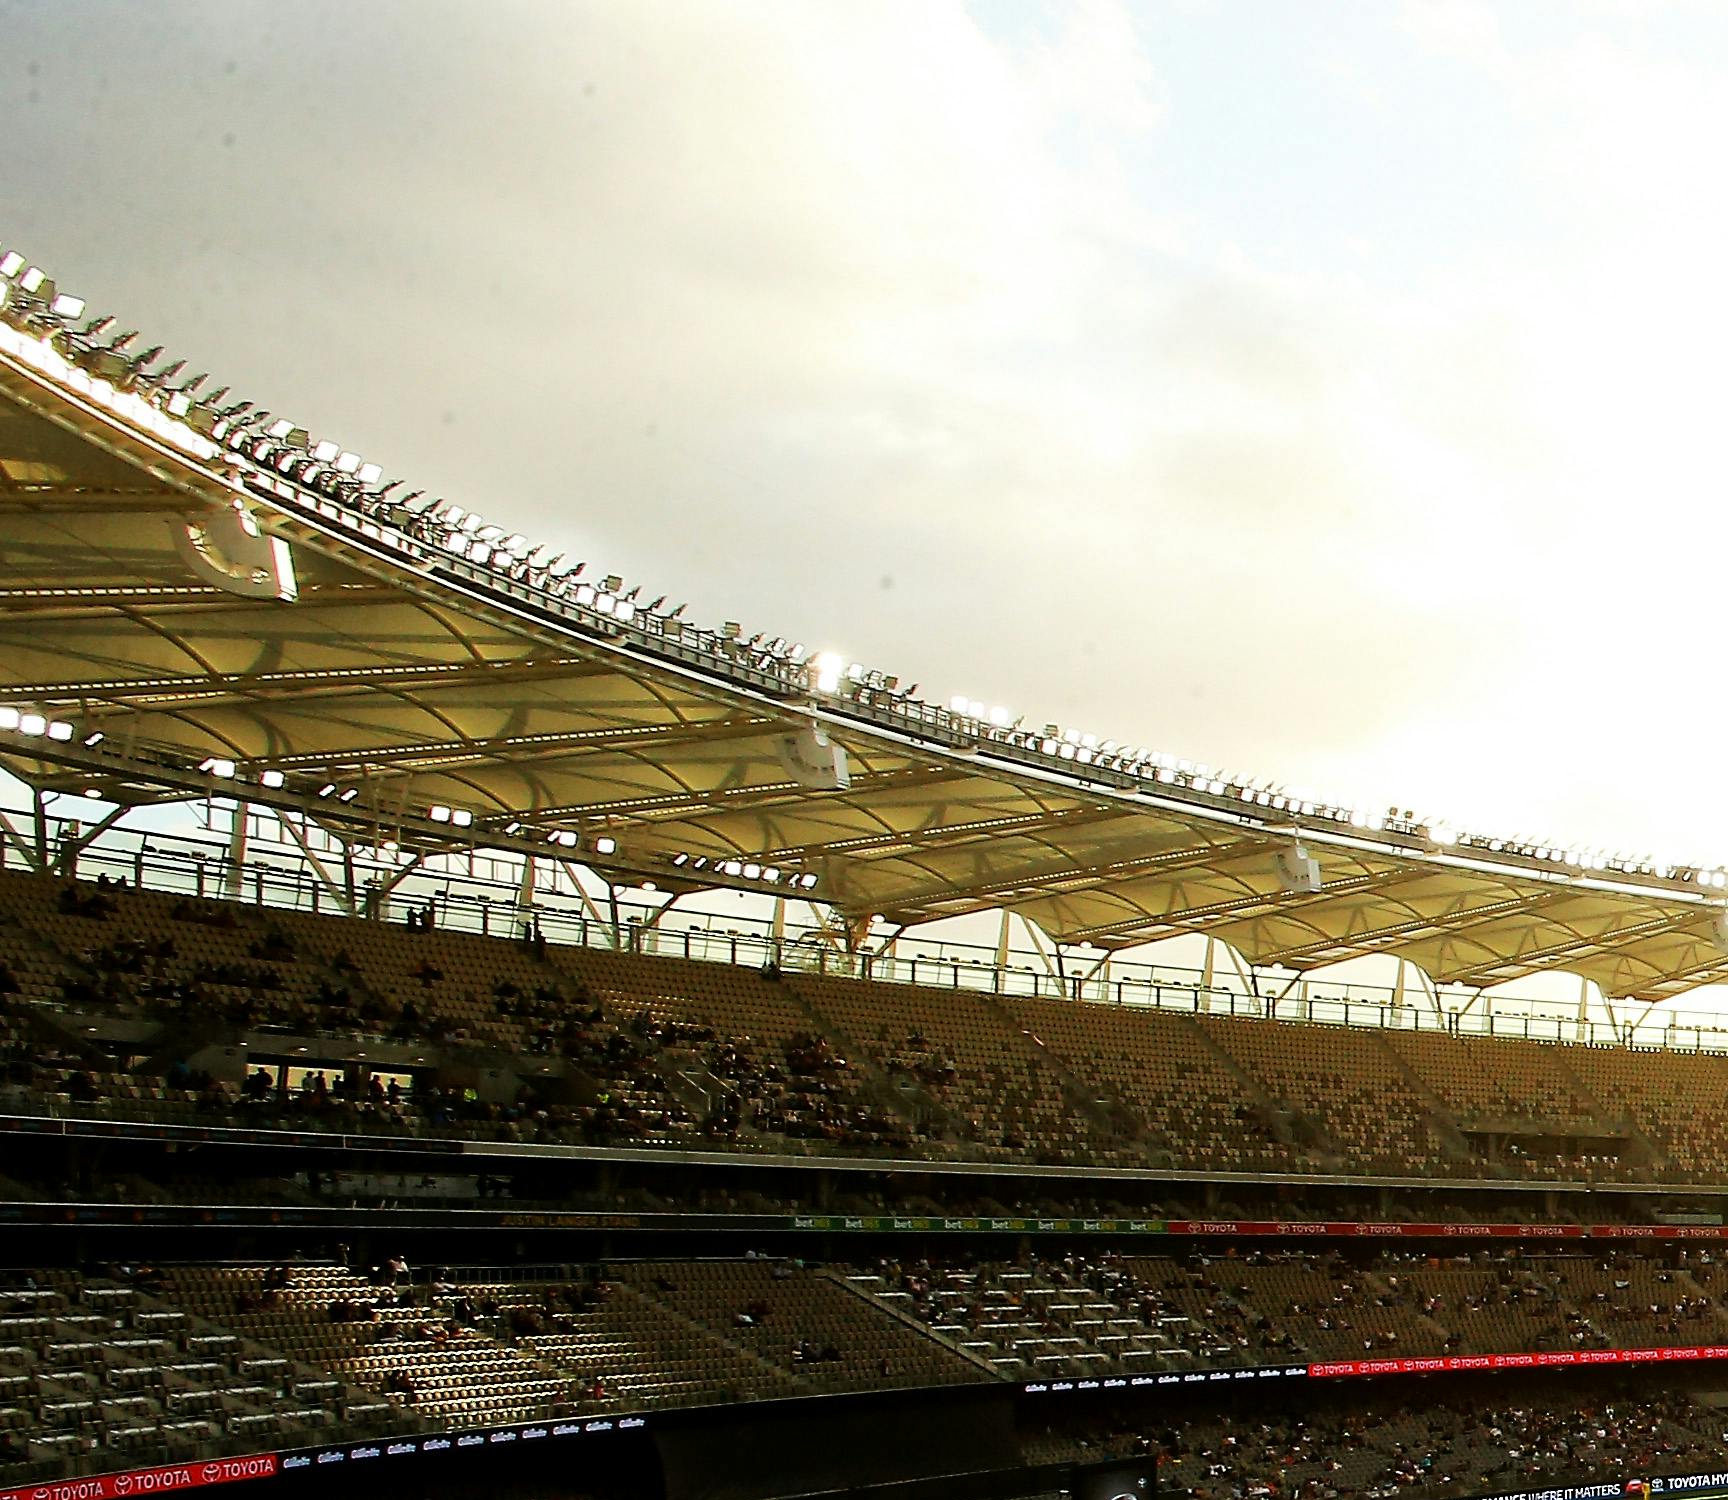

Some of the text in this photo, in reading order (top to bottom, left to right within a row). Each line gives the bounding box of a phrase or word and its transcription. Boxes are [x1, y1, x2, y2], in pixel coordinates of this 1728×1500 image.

[1548, 1355, 1575, 1364] TOYOTA
[1590, 1354, 1617, 1362] TOYOTA
[1632, 1352, 1658, 1360] TOYOTA
[1672, 1350, 1698, 1359] TOYOTA
[1371, 1361, 1399, 1371] TOYOTA
[1415, 1359, 1444, 1369] TOYOTA
[1461, 1358, 1490, 1368] TOYOTA
[1505, 1357, 1533, 1366] TOYOTA
[1324, 1365, 1354, 1375] TOYOTA
[1370, 1362, 1399, 1372] TOYOTA
[135, 1470, 191, 1490] TOYOTA
[223, 1459, 274, 1478] TOYOTA
[1668, 1476, 1711, 1490] TOYOTA
[1575, 1483, 1620, 1500] MATTERS
